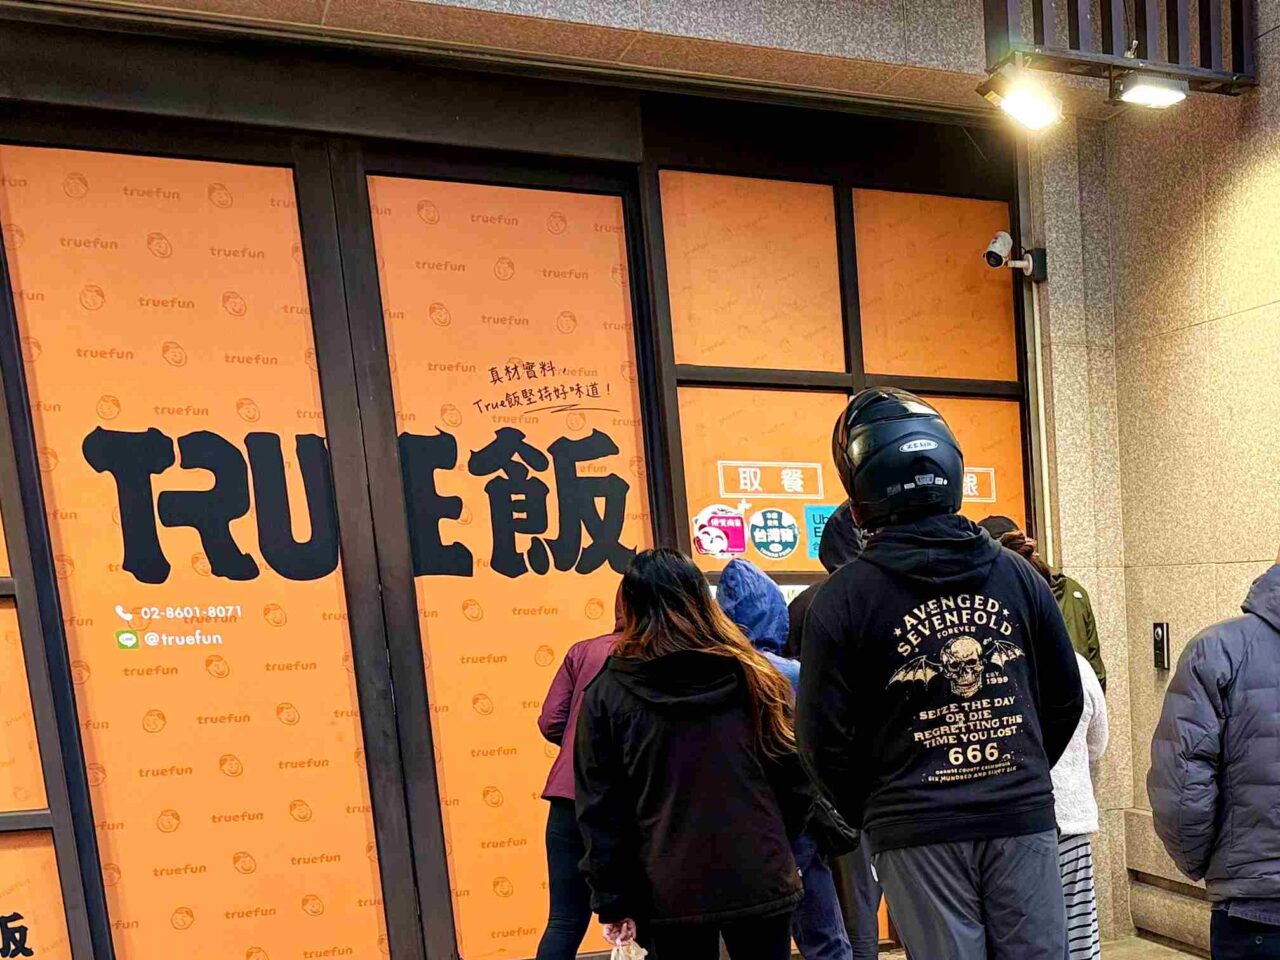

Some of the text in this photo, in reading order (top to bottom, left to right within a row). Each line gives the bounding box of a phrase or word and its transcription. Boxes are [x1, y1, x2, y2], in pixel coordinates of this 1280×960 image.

[123, 185, 180, 200] truefun
[470, 213, 519, 226] truefun
[59, 236, 265, 260] truefun truefun
[415, 260, 589, 280] truefun truefun
[138, 296, 195, 310] truefun
[481, 314, 529, 326] truefun
[75, 348, 278, 366] truefun truefun
[427, 361, 598, 377] truefun ruefun
[153, 405, 209, 417] truefun
[491, 414, 539, 426] truefun
[738, 467, 804, 493] 取餐
[963, 473, 979, 496] 銀
[141, 605, 242, 619] 02-8601-8071
[512, 606, 558, 617] truefun
[903, 594, 1000, 630] AVENGED
[144, 629, 223, 646] @truefun
[897, 610, 1012, 656] SEVENFOLD
[937, 625, 976, 639] FOREVER
[459, 654, 507, 665] truefun
[123, 661, 317, 678] truefun truefun
[919, 696, 1016, 720] SEIZE THE DAY
[197, 713, 251, 725] truefun
[945, 710, 992, 722] OR DIE
[914, 715, 1023, 741] REGRETTING THE
[923, 726, 1018, 749] TIME YOU LOST
[470, 746, 517, 758] truefun
[949, 742, 999, 765] 666
[138, 758, 329, 778] truefun truefun
[940, 773, 972, 782] HUNDRED
[211, 811, 263, 824] truefun
[481, 838, 527, 849] truefun
[152, 854, 341, 877] truefun truefun
[224, 907, 276, 920] truefun
[490, 926, 537, 939] truefun
[303, 947, 353, 959] truefun
